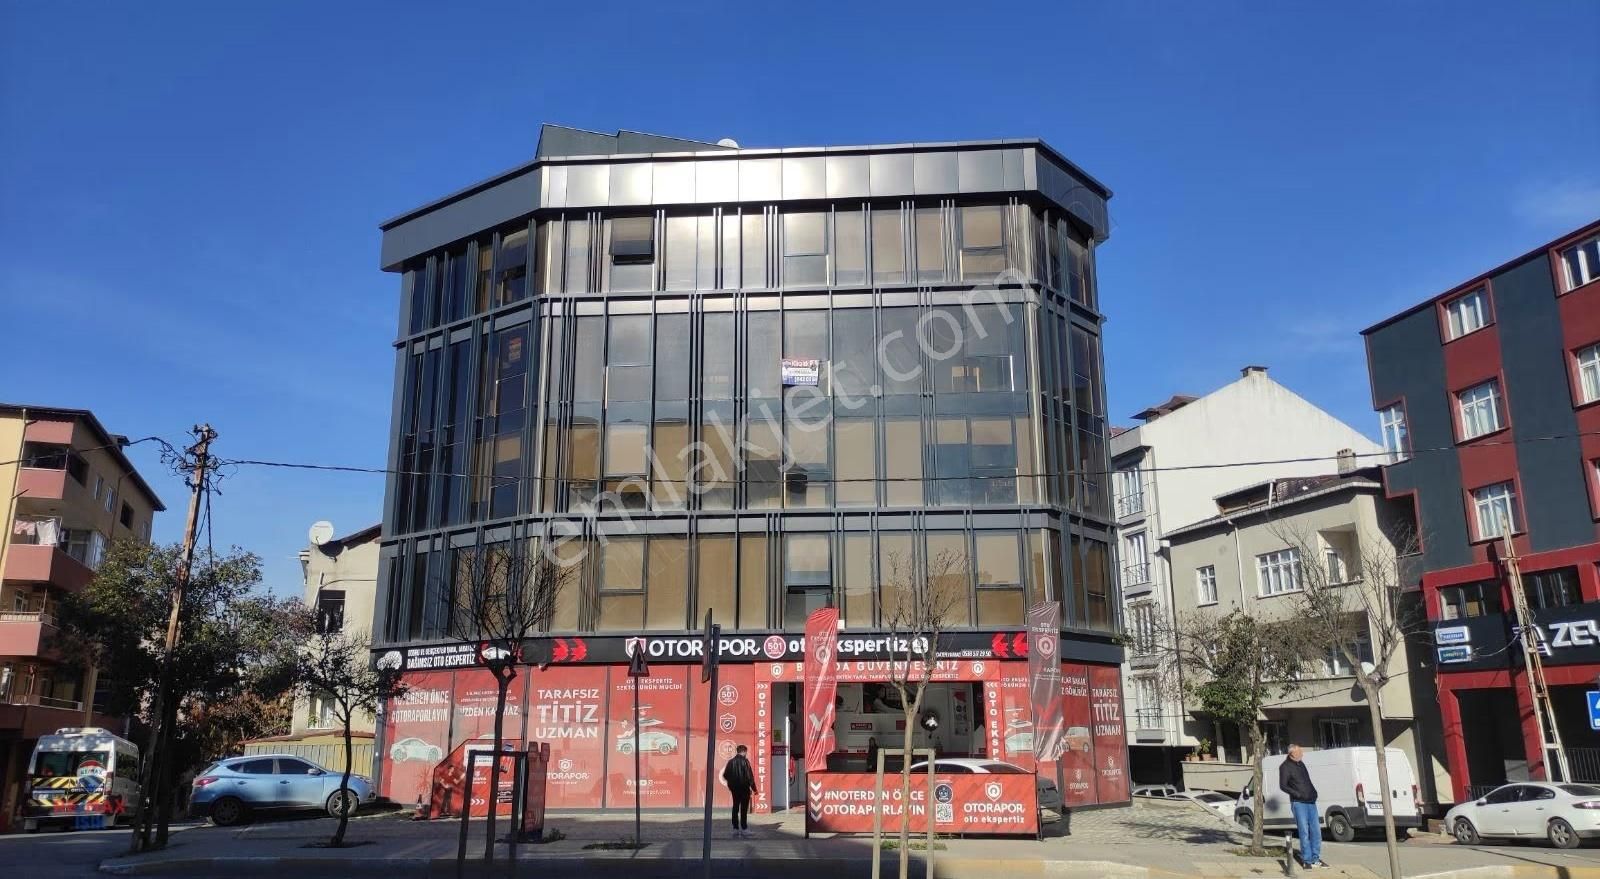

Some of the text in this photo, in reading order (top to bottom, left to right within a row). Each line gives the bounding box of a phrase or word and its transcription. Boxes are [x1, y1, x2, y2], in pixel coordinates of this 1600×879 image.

[649, 639, 761, 656] OTORPOR
[767, 642, 782, 650] 501
[789, 637, 909, 655] ot kspertiz
[407, 652, 476, 669] BAĞIMSIZ OTO EKSPERTİZ
[393, 691, 429, 706] NOERDEN
[430, 688, 449, 704] ÖNCE
[537, 688, 600, 700] TARAFSIZ
[1092, 688, 1118, 698] TARAFSIZ
[988, 691, 997, 716] OTO
[485, 705, 519, 717] KAMAZ
[536, 700, 599, 723] TİTİZ
[1094, 699, 1120, 721] TİTİZ
[535, 727, 598, 739] UZMAN
[1095, 725, 1121, 736] UZMAN
[758, 692, 767, 801] OTO EKSPERTİZ
[547, 772, 590, 780] TORAPOR
[824, 788, 924, 801] #NOTERDN ÖCE
[823, 804, 924, 815] OTORAPRLAIN
[963, 803, 1026, 813] OTORAPOR
[964, 815, 1025, 825] oto ekspertiz
